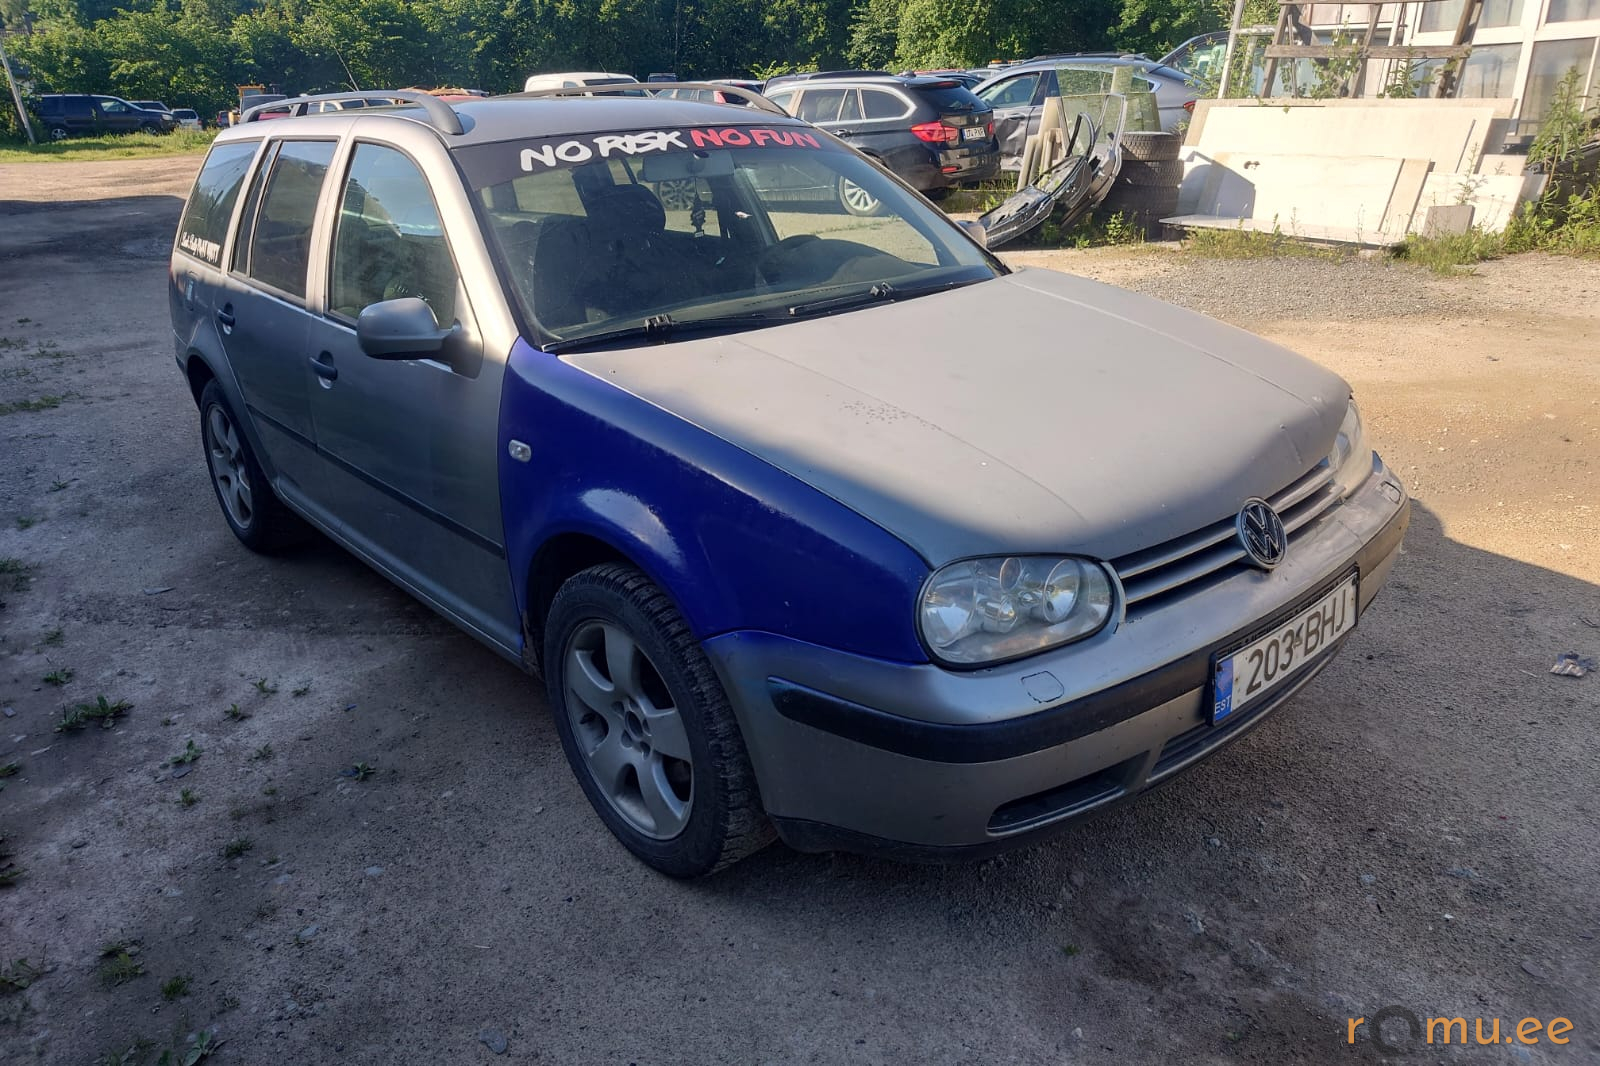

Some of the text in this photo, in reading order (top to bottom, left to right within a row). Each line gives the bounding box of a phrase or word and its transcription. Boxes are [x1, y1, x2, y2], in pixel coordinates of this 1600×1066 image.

[520, 128, 821, 172] NO RISK NO FUN
[1246, 629, 1295, 695] 203
[1303, 589, 1347, 657] BHJ
[1214, 695, 1232, 713] EST
